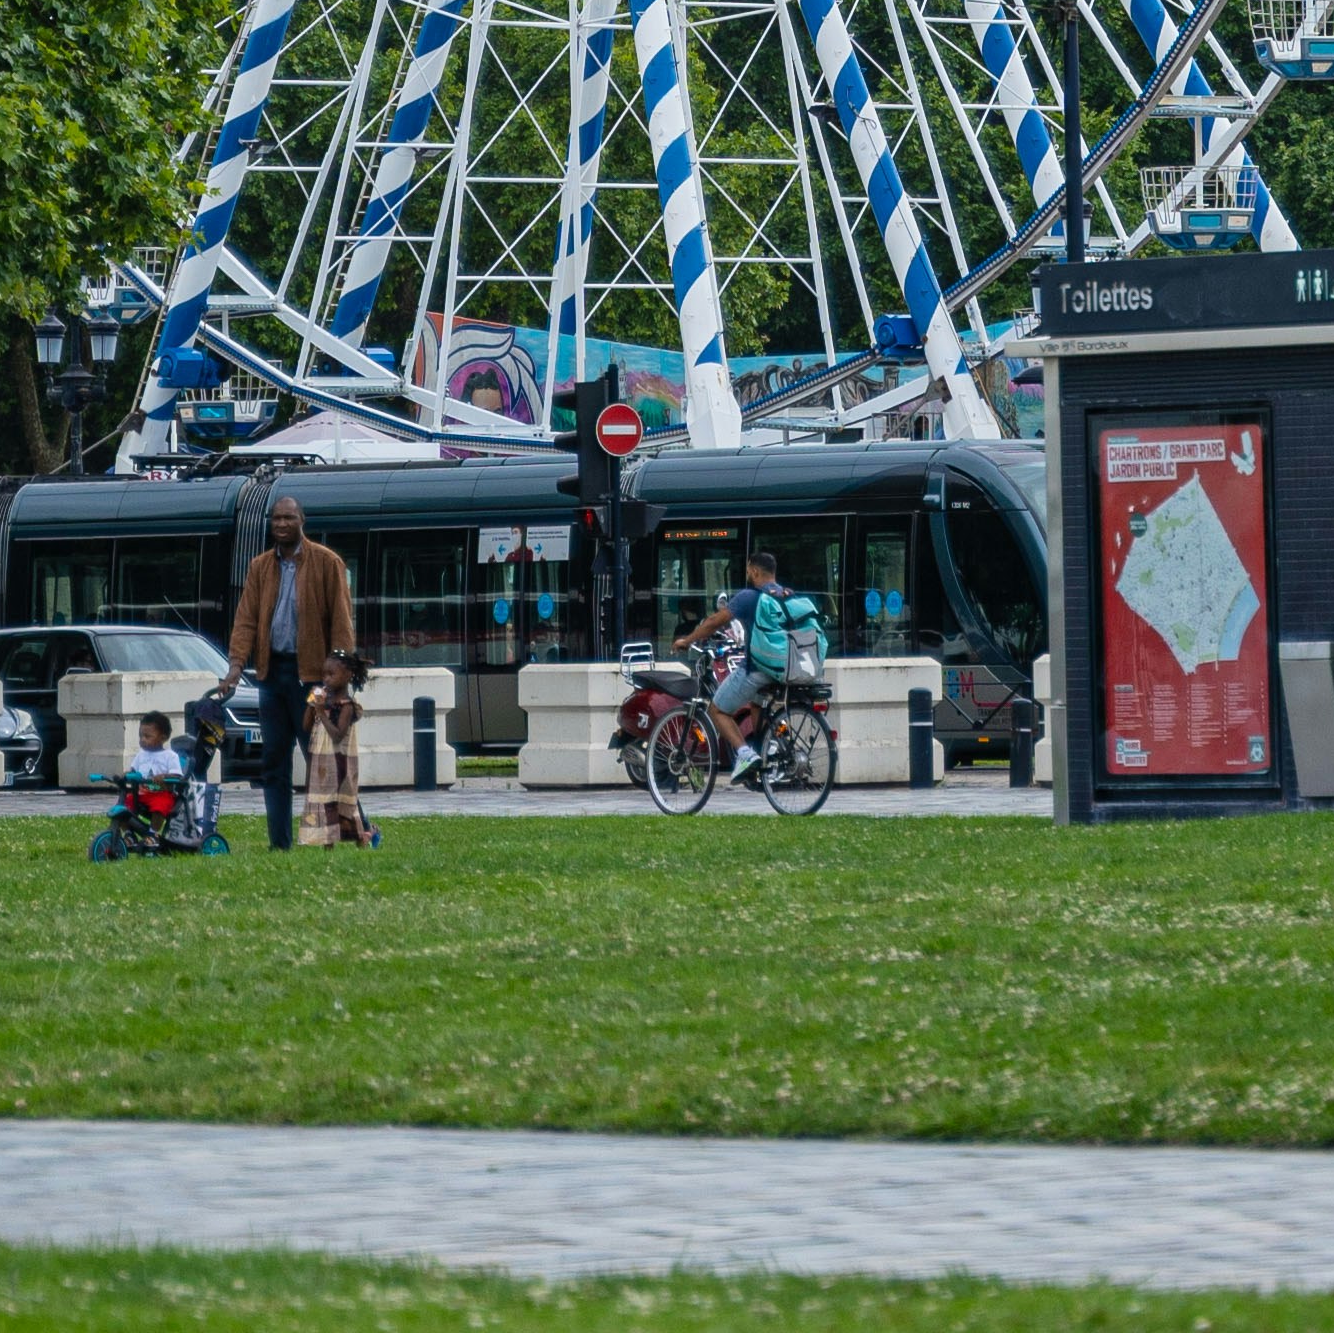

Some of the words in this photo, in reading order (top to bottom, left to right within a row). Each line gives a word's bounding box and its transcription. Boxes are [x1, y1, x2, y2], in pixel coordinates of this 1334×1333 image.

[1060, 281, 1153, 314] Toilettes
[1039, 342, 1060, 354] Ville
[1077, 340, 1129, 351] Bordeaux
[1108, 445, 1161, 461] CHARTRONS
[1169, 443, 1199, 459] GRAND
[1200, 442, 1224, 458] PARC
[1109, 463, 1141, 479] JARDIN
[1143, 462, 1175, 477] PUBLIC
